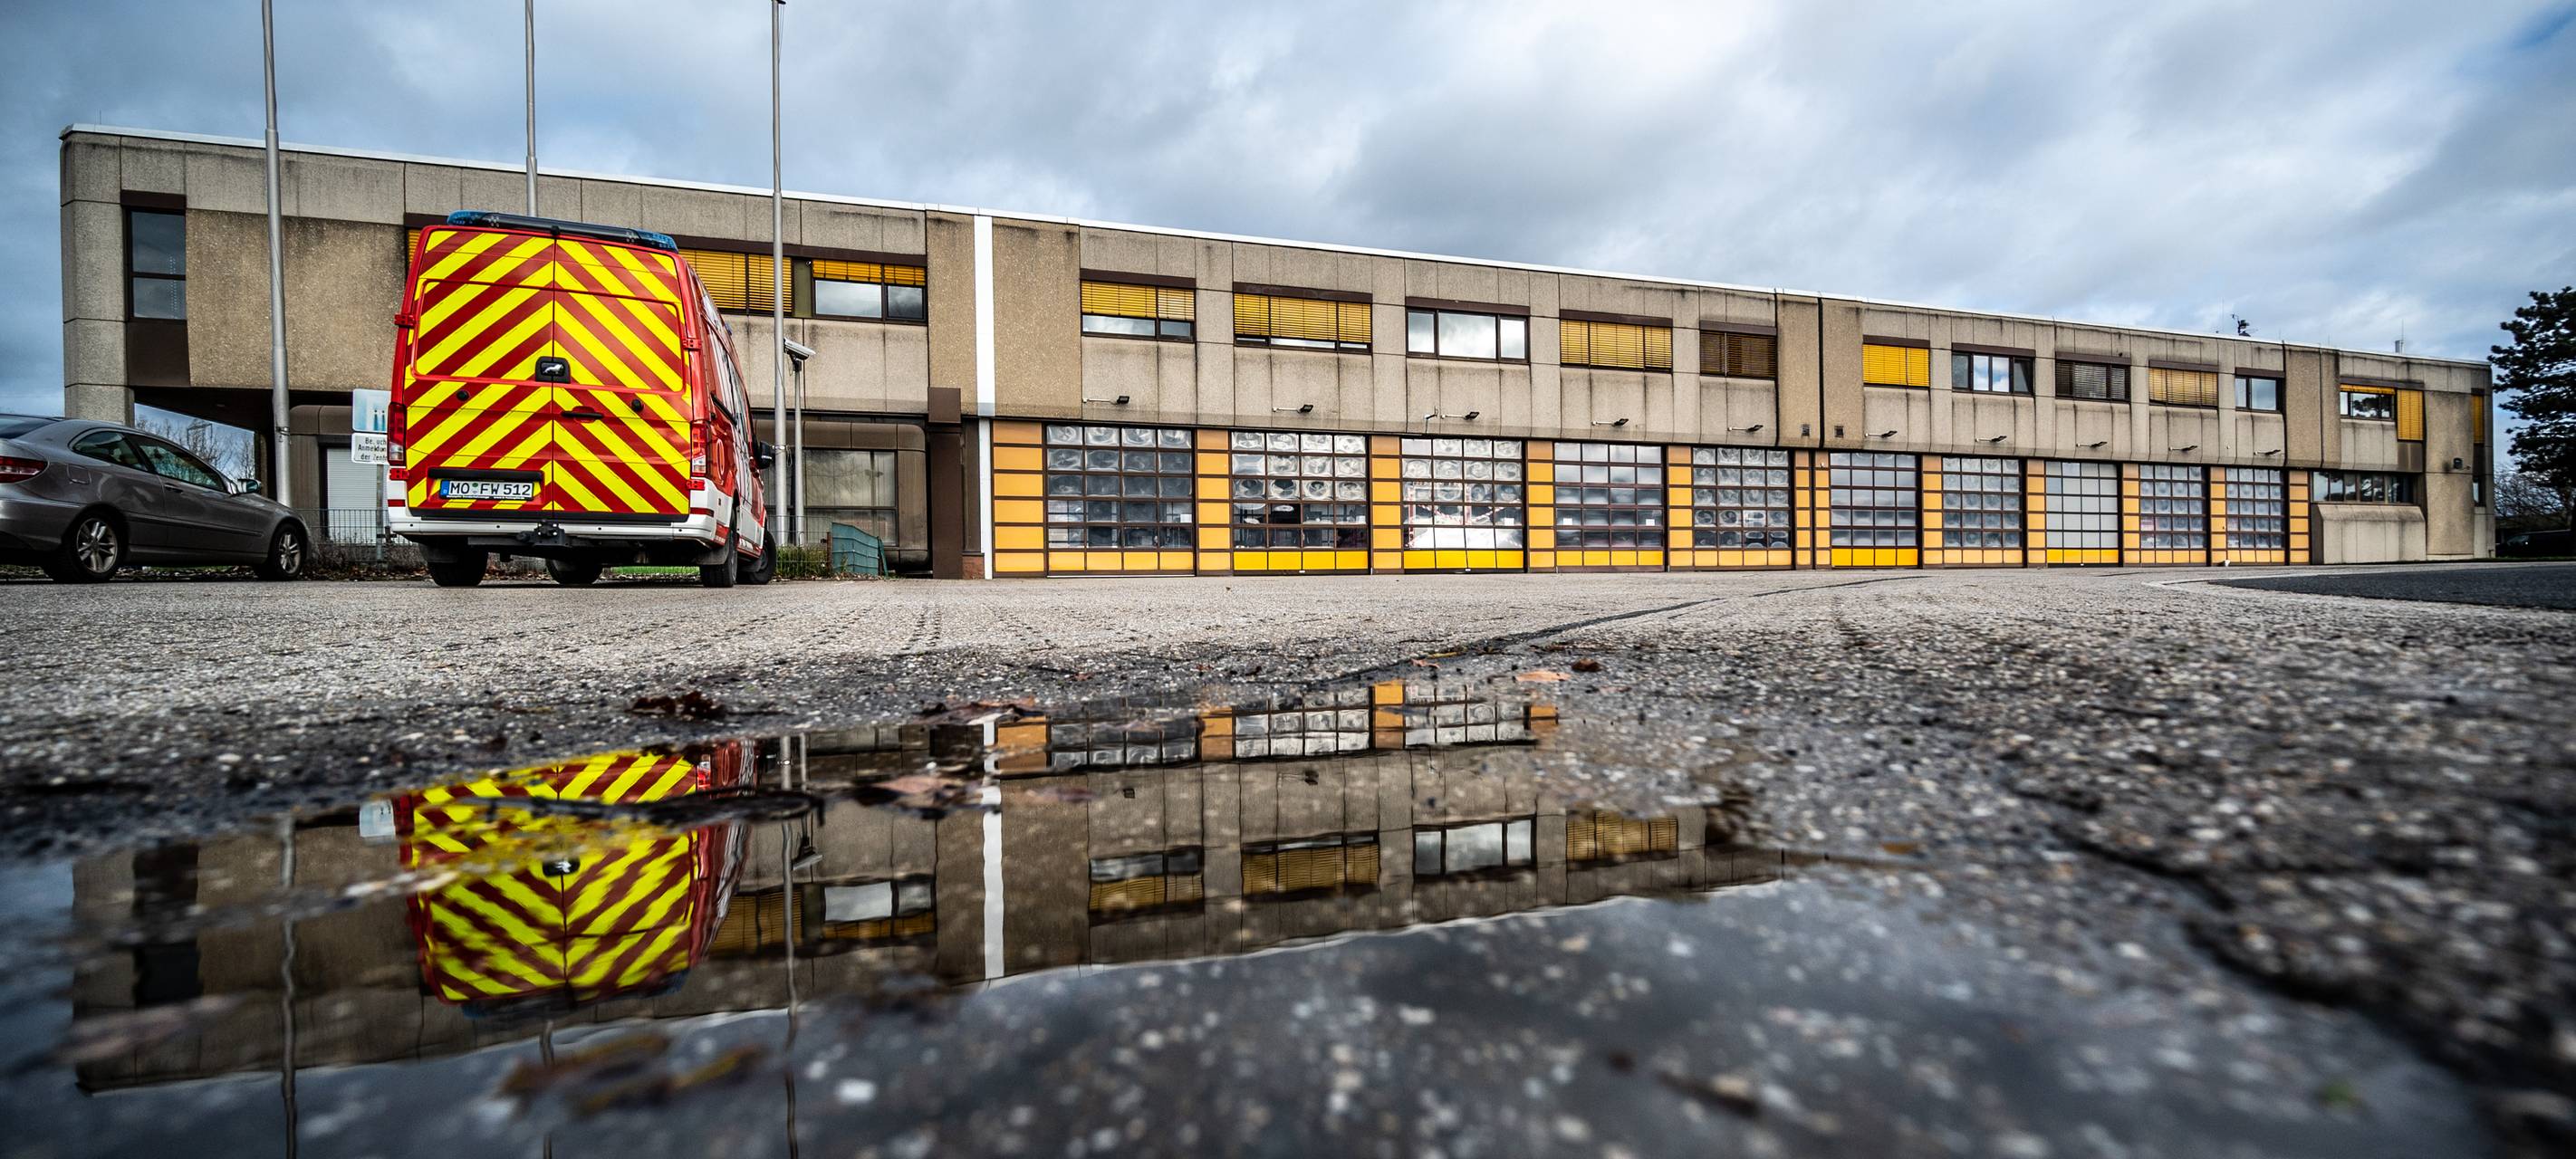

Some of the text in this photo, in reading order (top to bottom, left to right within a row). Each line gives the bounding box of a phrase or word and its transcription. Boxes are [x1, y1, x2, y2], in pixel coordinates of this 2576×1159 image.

[450, 482, 531, 495] MO FW 512
